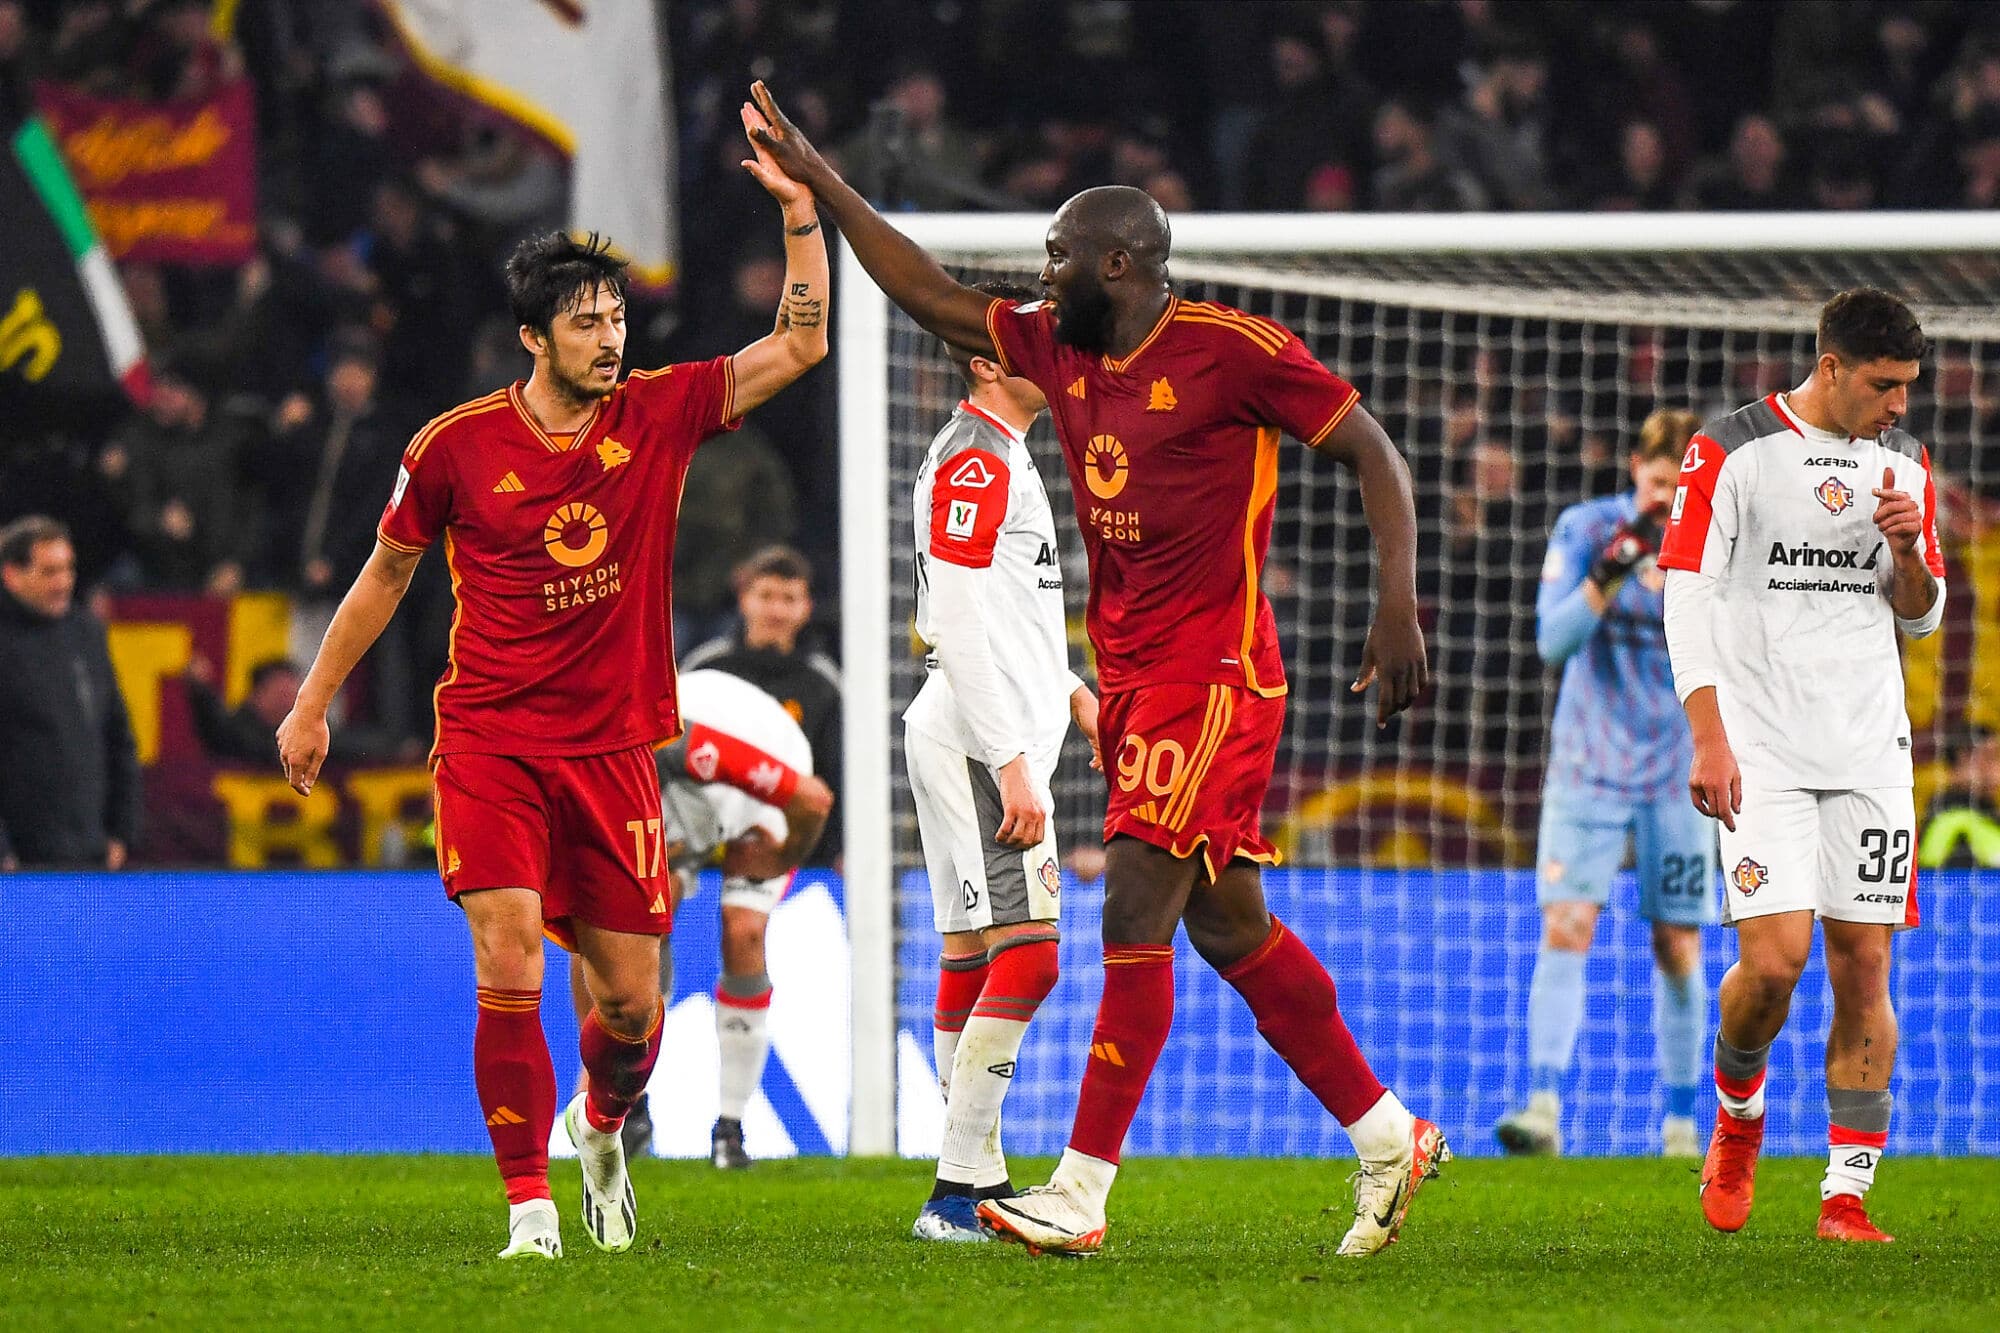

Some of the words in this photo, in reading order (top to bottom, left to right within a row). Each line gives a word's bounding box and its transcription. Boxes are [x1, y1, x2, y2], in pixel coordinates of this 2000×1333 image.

[1090, 506, 1139, 526] YADH
[1102, 525, 1141, 542] SON
[1767, 541, 1859, 568] Arinox
[543, 562, 619, 596] RIYADH
[546, 578, 622, 612] SEASON
[1767, 578, 1876, 595] AcciaieriaArvedi
[1117, 734, 1185, 797] 90
[626, 817, 661, 879] 17
[1858, 829, 1910, 884] 32
[1662, 852, 1706, 897] 22
